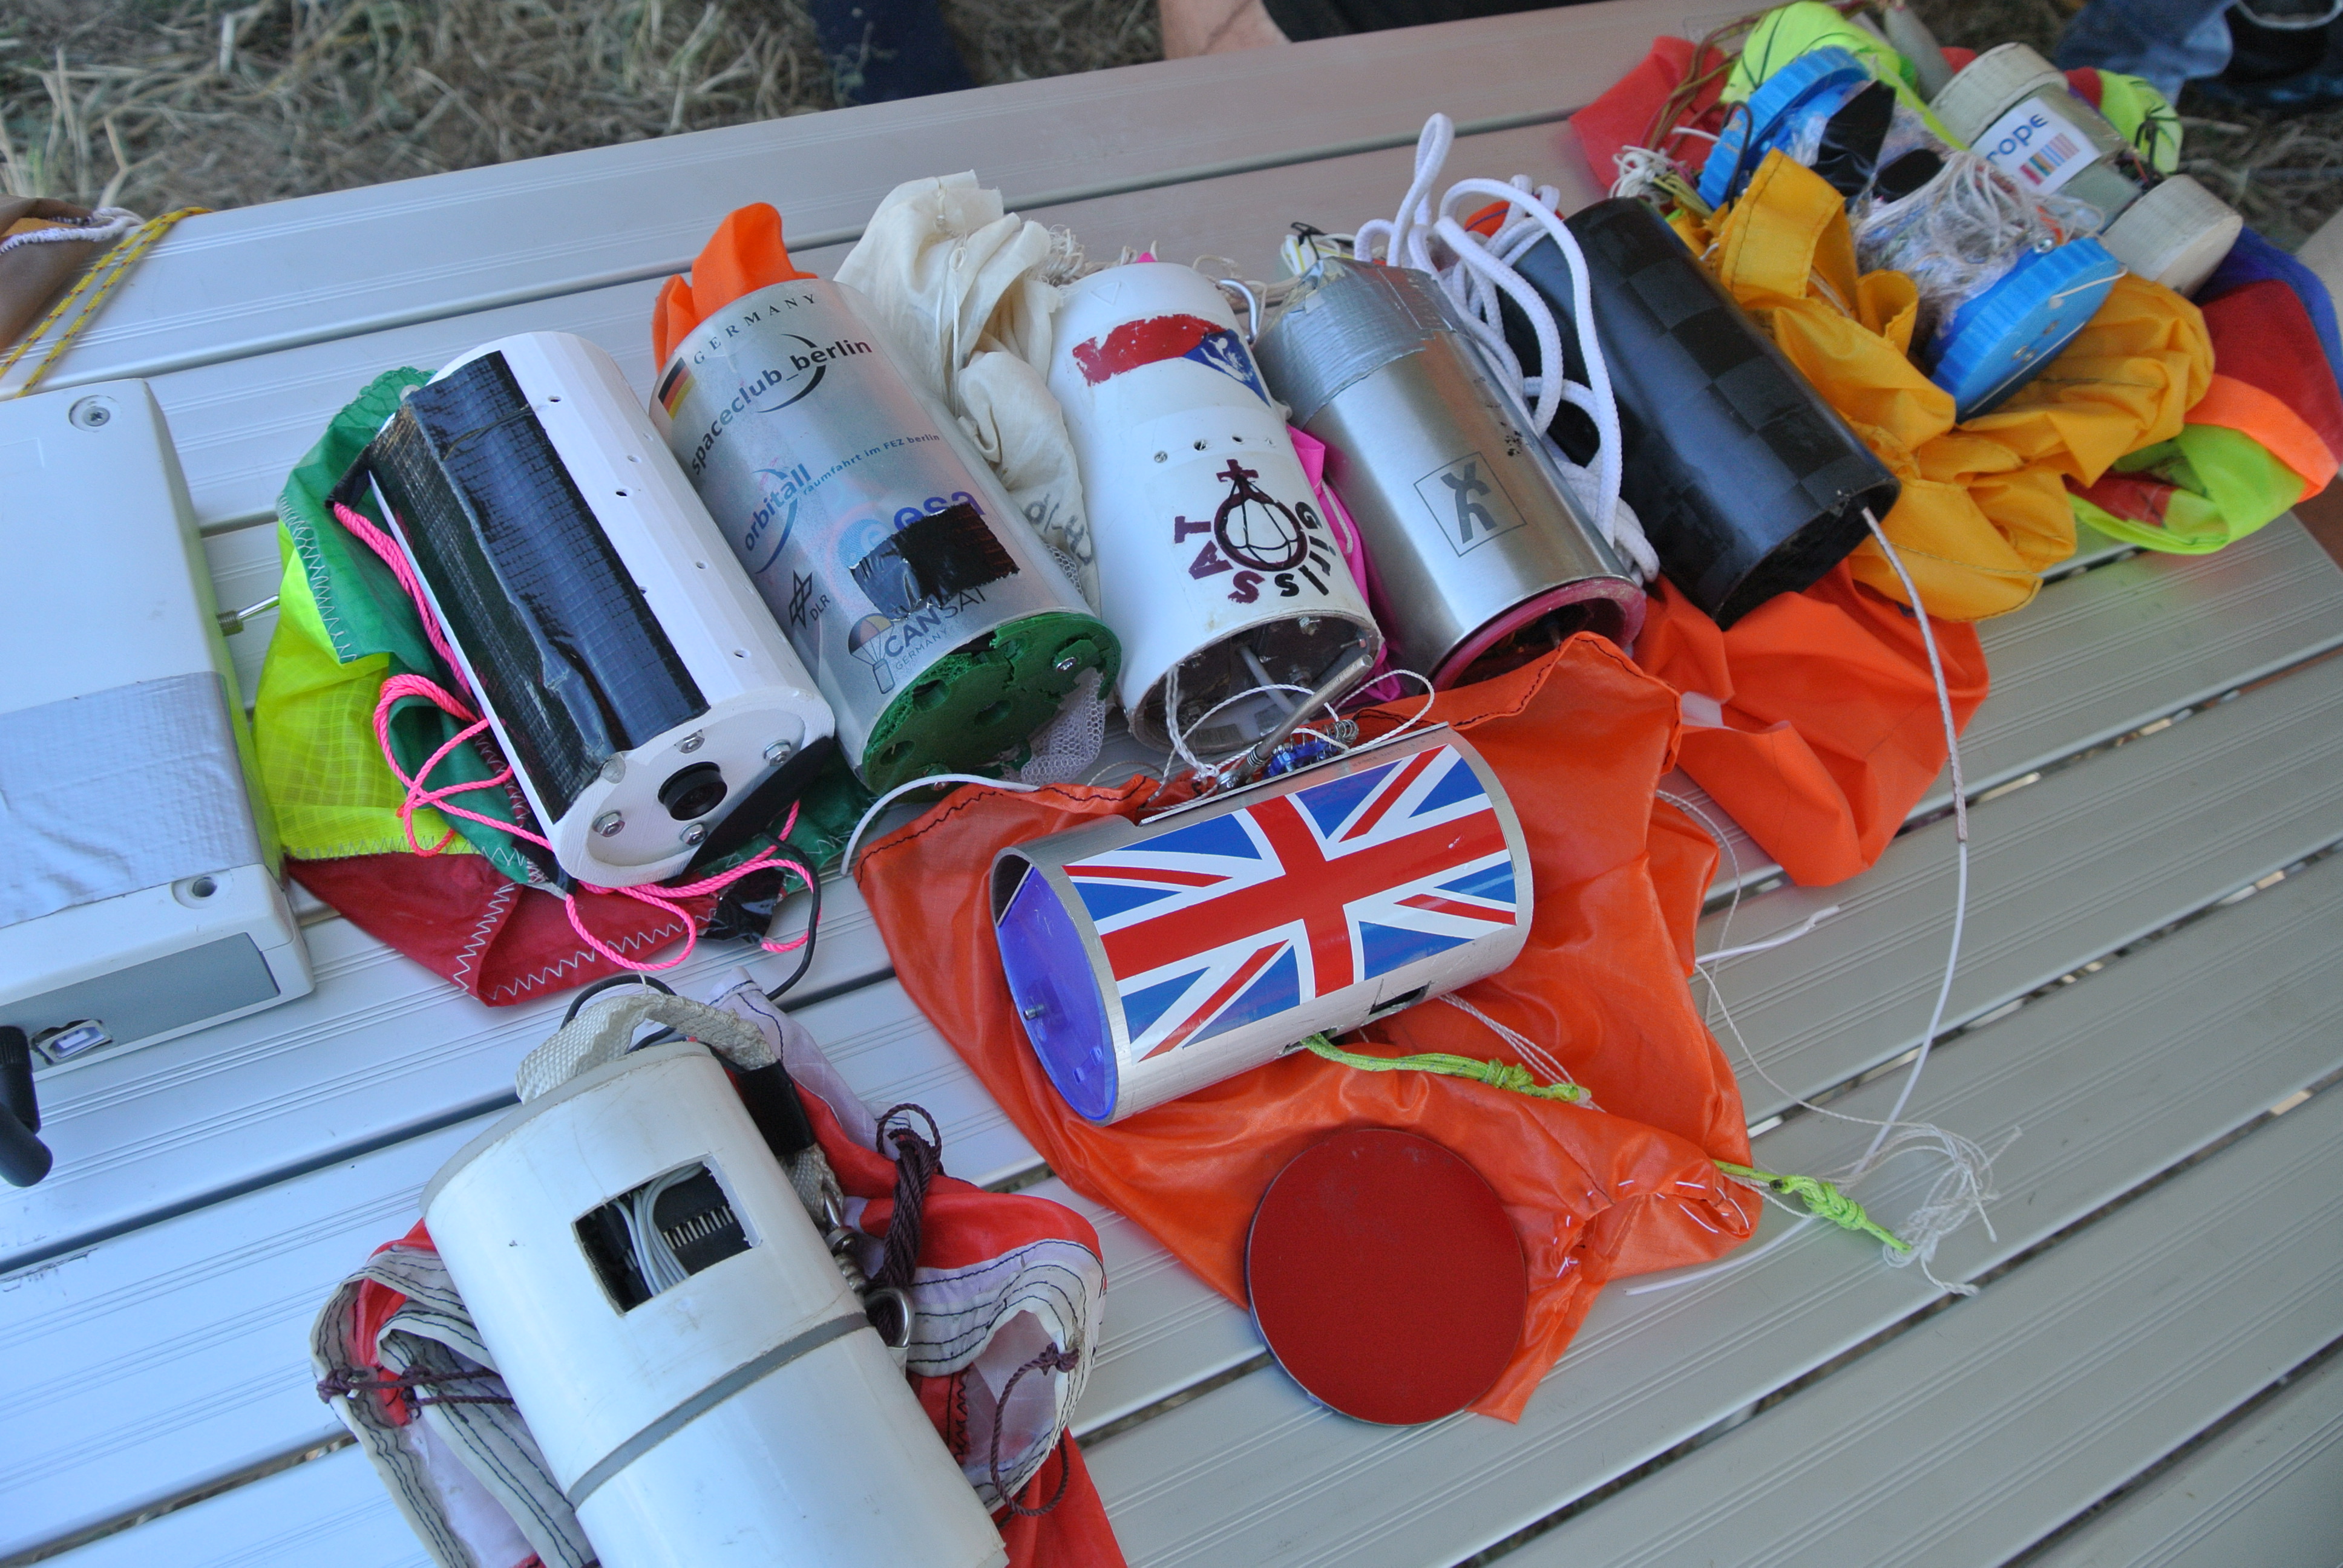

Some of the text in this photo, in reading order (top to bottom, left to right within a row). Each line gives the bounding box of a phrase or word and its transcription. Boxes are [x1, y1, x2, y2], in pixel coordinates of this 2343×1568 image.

[693, 293, 816, 365] GERMANY
[691, 339, 873, 475] spaceclub_berlin
[802, 433, 940, 495] raumfahrt im FEZ berlin
[744, 463, 812, 552] orbitall
[1173, 515, 1267, 604] SAT
[1274, 501, 1337, 597] Girls
[809, 593, 831, 621] DLR
[895, 627, 948, 670] GERMANY
